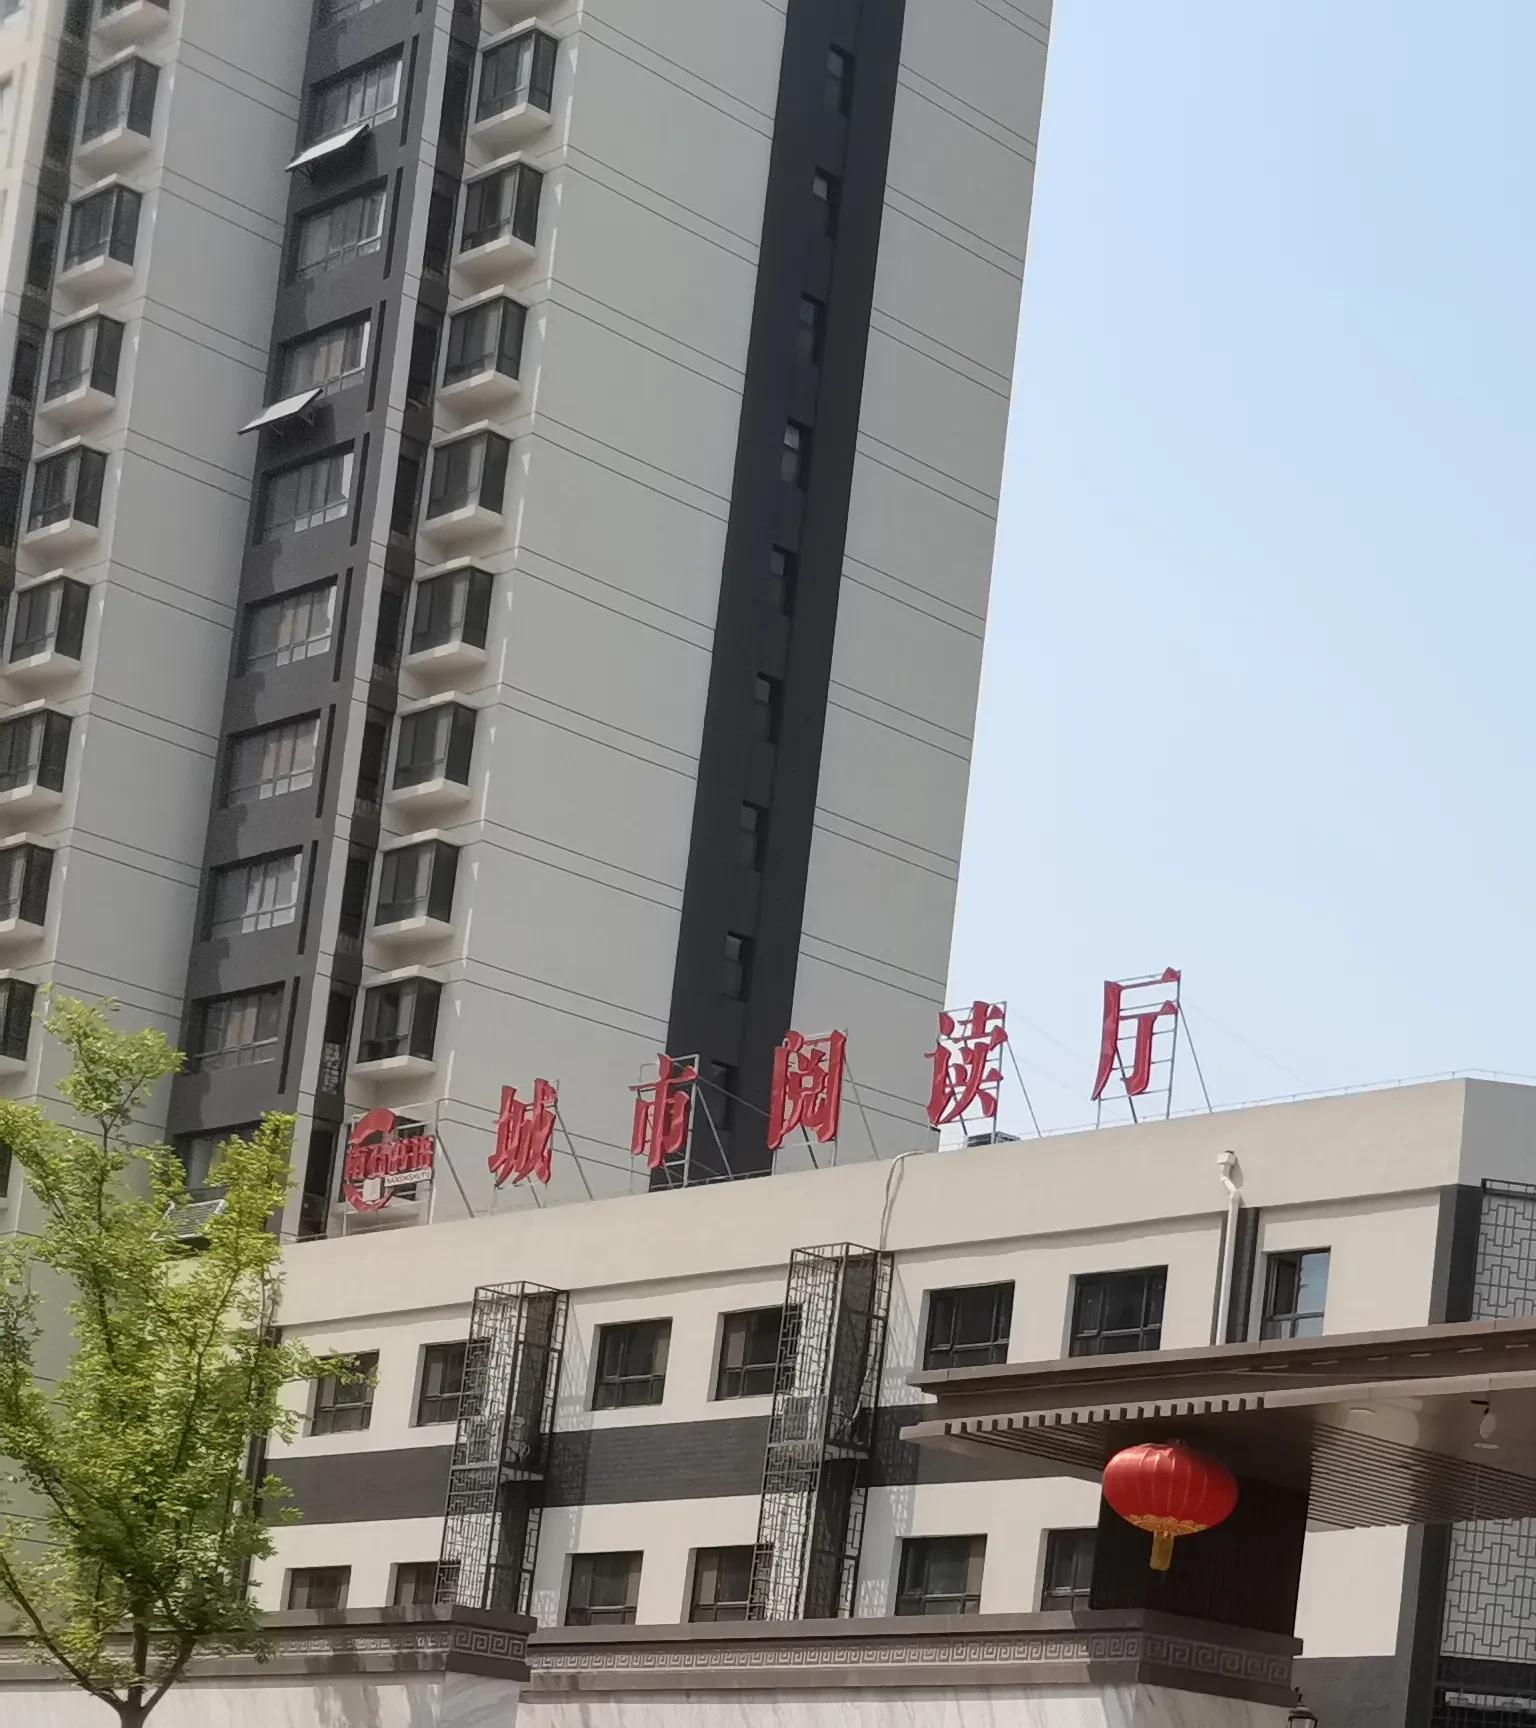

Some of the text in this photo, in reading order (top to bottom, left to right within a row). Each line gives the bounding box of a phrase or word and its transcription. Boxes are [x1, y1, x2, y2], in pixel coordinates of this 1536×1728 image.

[487, 967, 1182, 1188] 城市阅读厅
